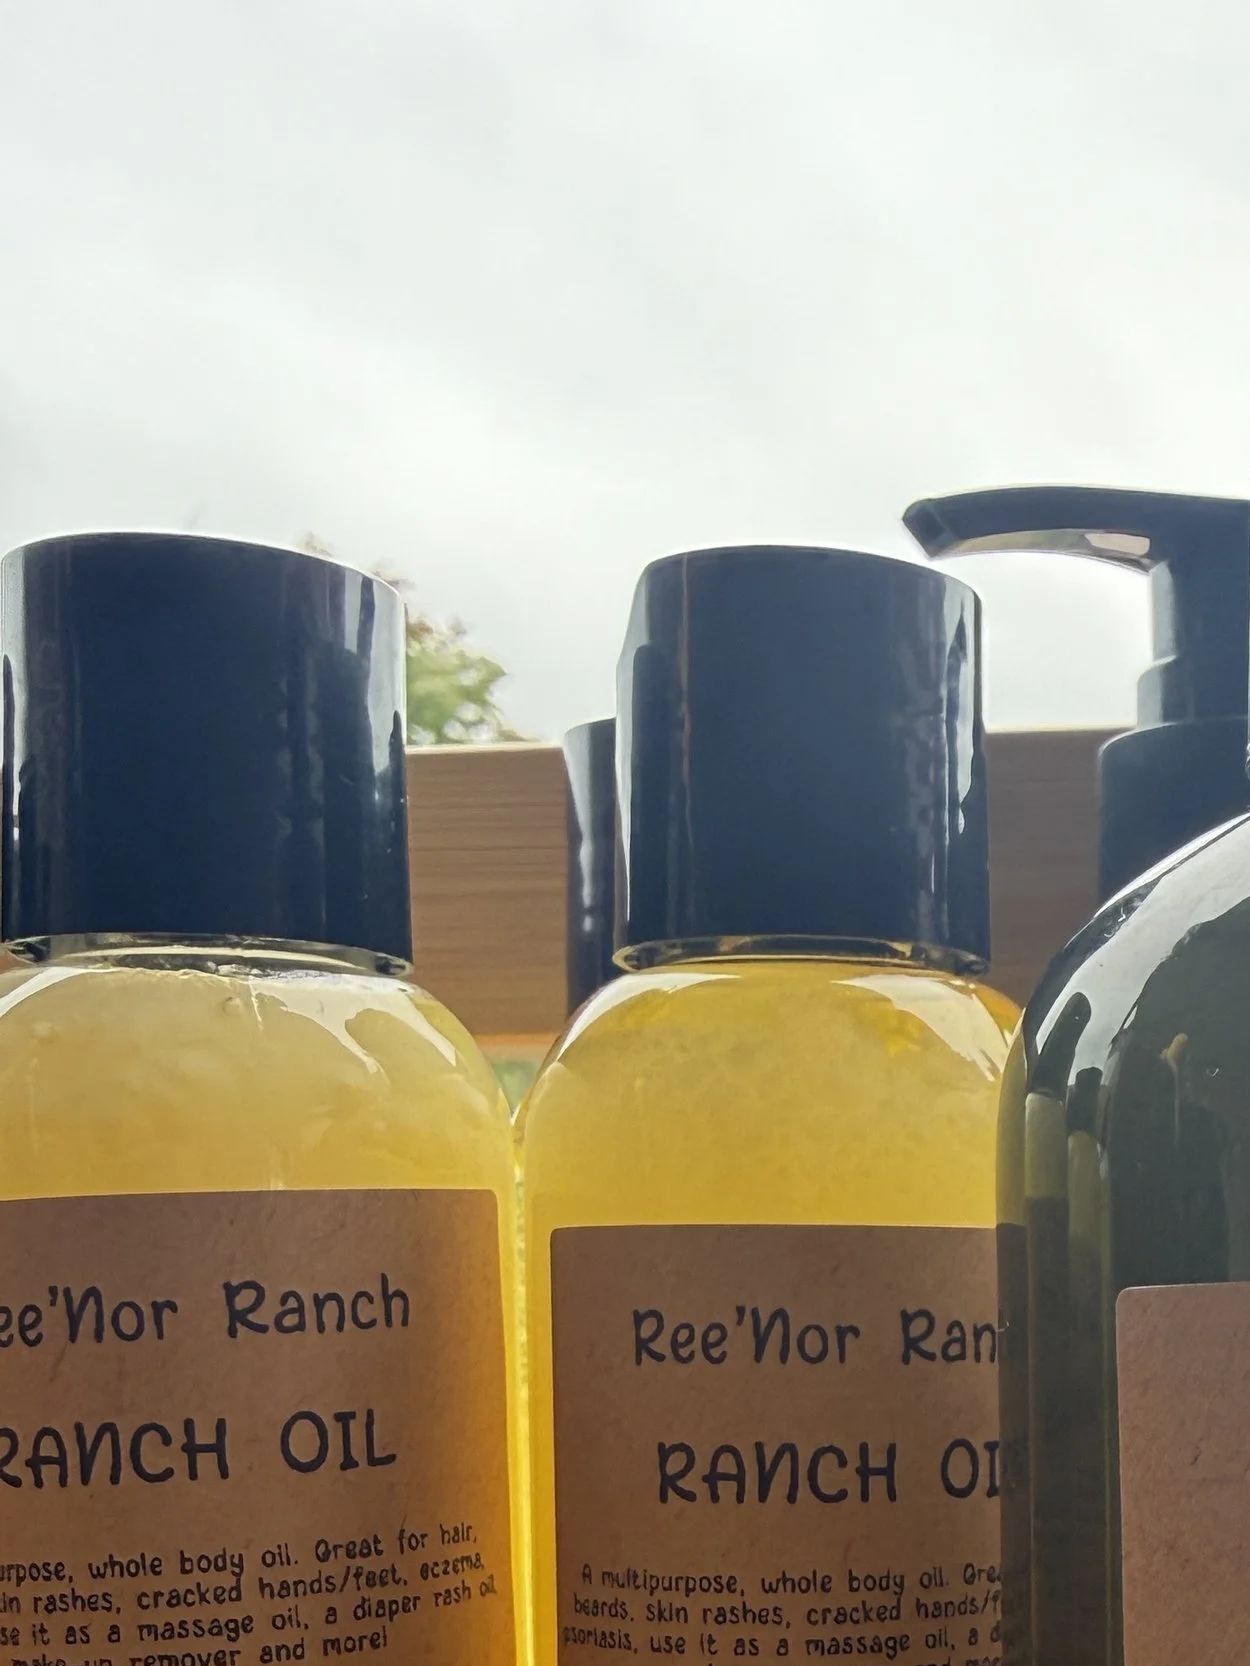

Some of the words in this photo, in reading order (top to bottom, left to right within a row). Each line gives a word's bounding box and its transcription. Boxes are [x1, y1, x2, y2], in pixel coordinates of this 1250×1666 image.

[0, 1284, 178, 1348] ee'Nor
[223, 1272, 410, 1339] Ranch
[632, 1303, 861, 1367] Ree'Nor
[900, 1307, 999, 1366] Ran
[280, 1407, 398, 1474] OIL
[656, 1440, 898, 1505] RANCH
[940, 1437, 1000, 1499] OI
[88, 1552, 163, 1580] whole
[180, 1547, 245, 1578] body
[261, 1542, 299, 1568] oil.
[315, 1534, 384, 1564] Great
[399, 1528, 429, 1555] for
[440, 1521, 478, 1545] hair,
[580, 1562, 593, 1587] A
[601, 1567, 746, 1598] multipurpose,
[761, 1569, 833, 1594] whole
[848, 1567, 906, 1598] body
[31, 1622, 51, 1647] it
[64, 1624, 91, 1646] as
[107, 1624, 121, 1644] a
[137, 1615, 254, 1643] massage
[271, 1604, 311, 1631] oil,
[325, 1606, 338, 1626] a
[353, 1595, 421, 1624] diaper
[433, 1579, 473, 1608] rash
[33, 1586, 122, 1616] rashes,
[137, 1577, 243, 1611] cracked
[258, 1562, 408, 1601] hands/feet,
[646, 1599, 690, 1626] skin
[702, 1600, 792, 1630] rashes,
[805, 1596, 902, 1627] cracked
[259, 1637, 306, 1665] and
[649, 1634, 687, 1656] use
[699, 1632, 719, 1656] it
[733, 1637, 761, 1657] as
[776, 1637, 790, 1657] a
[804, 1632, 911, 1661] massage
[924, 1625, 956, 1651] oil,
[967, 1626, 980, 1647] a
